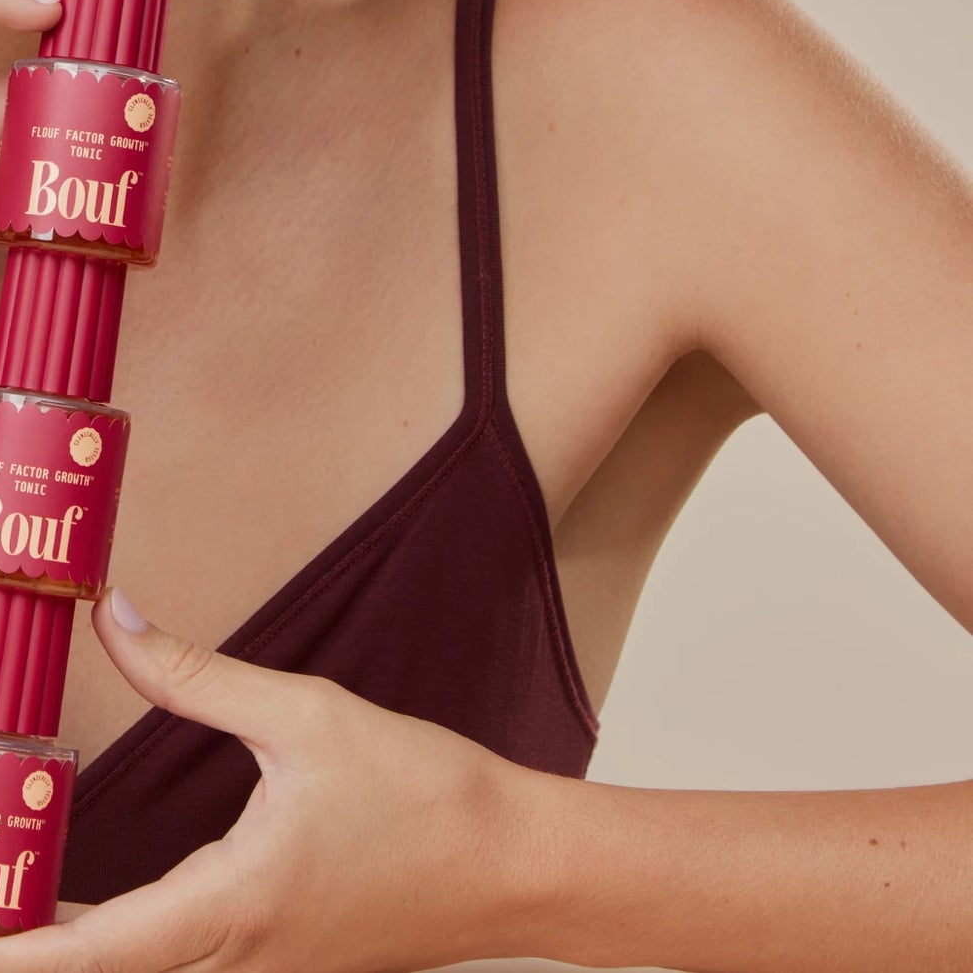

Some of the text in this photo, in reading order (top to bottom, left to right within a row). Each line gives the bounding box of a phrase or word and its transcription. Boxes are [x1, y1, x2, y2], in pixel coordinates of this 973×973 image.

[31, 126, 60, 138] FLOUF
[65, 129, 105, 145] FACTOR
[70, 145, 102, 161] TONIC
[9, 463, 49, 480] FACTOR
[14, 480, 47, 496] TONIC
